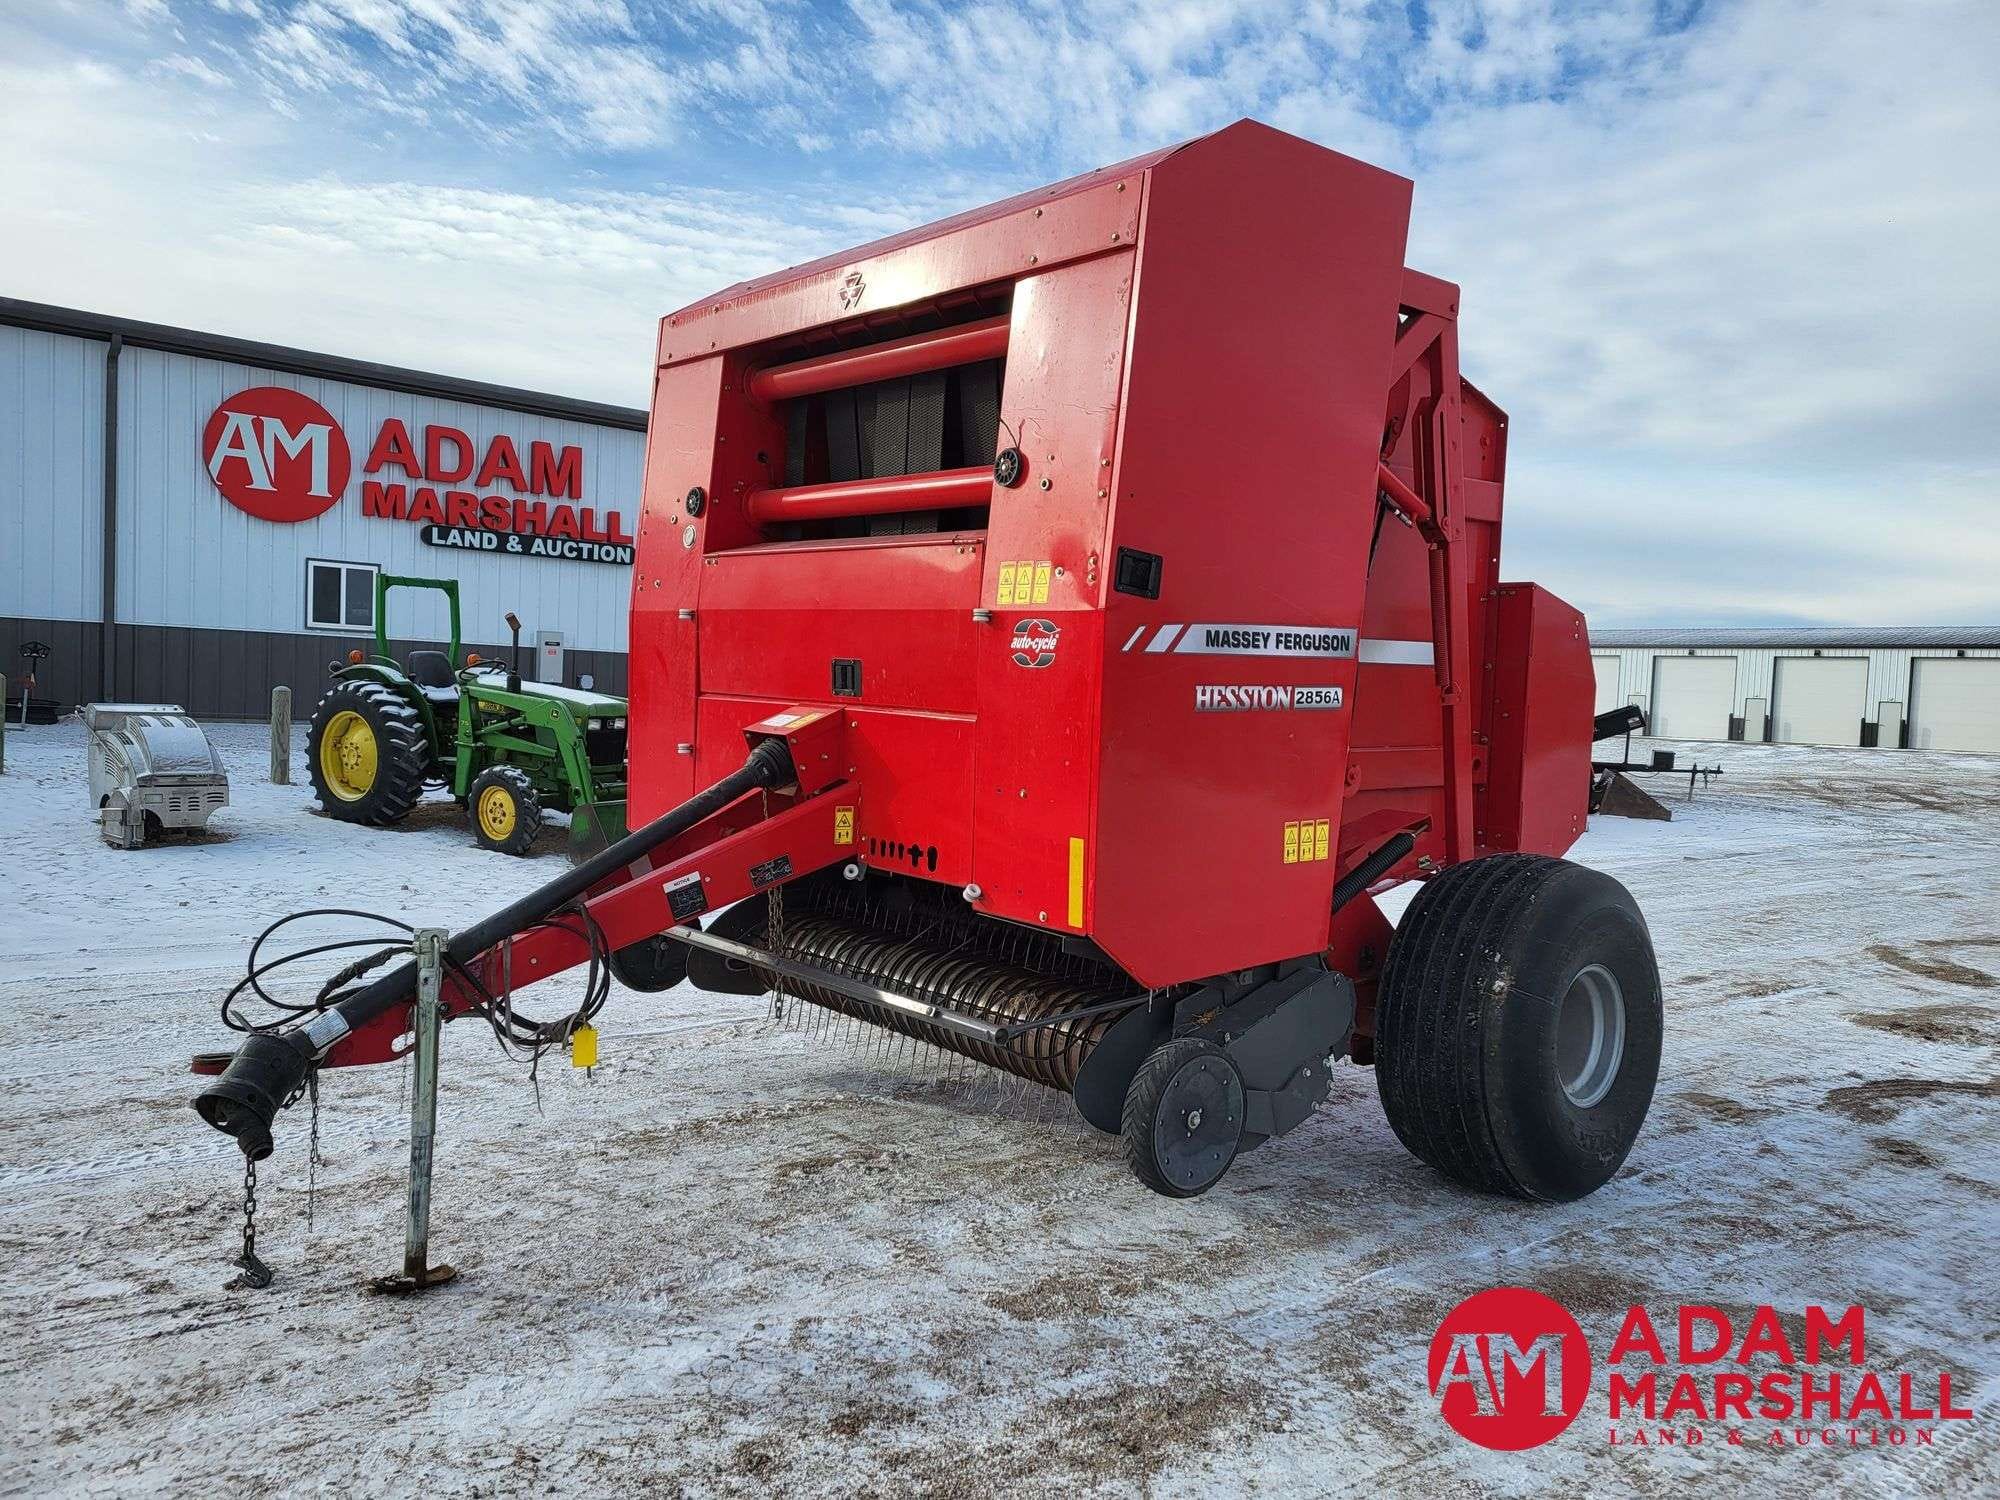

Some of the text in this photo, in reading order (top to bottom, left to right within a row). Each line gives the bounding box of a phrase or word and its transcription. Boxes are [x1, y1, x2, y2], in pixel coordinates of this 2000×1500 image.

[208, 410, 334, 498] AM
[363, 417, 583, 500] ADAM
[362, 480, 633, 544] MARSHALL
[431, 527, 631, 564] LAND & AUCTION
[1205, 629, 1350, 652] MASSEY FERGUSON
[1195, 685, 1341, 712] HESSTON 2856A
[673, 877, 690, 887] NOTICE
